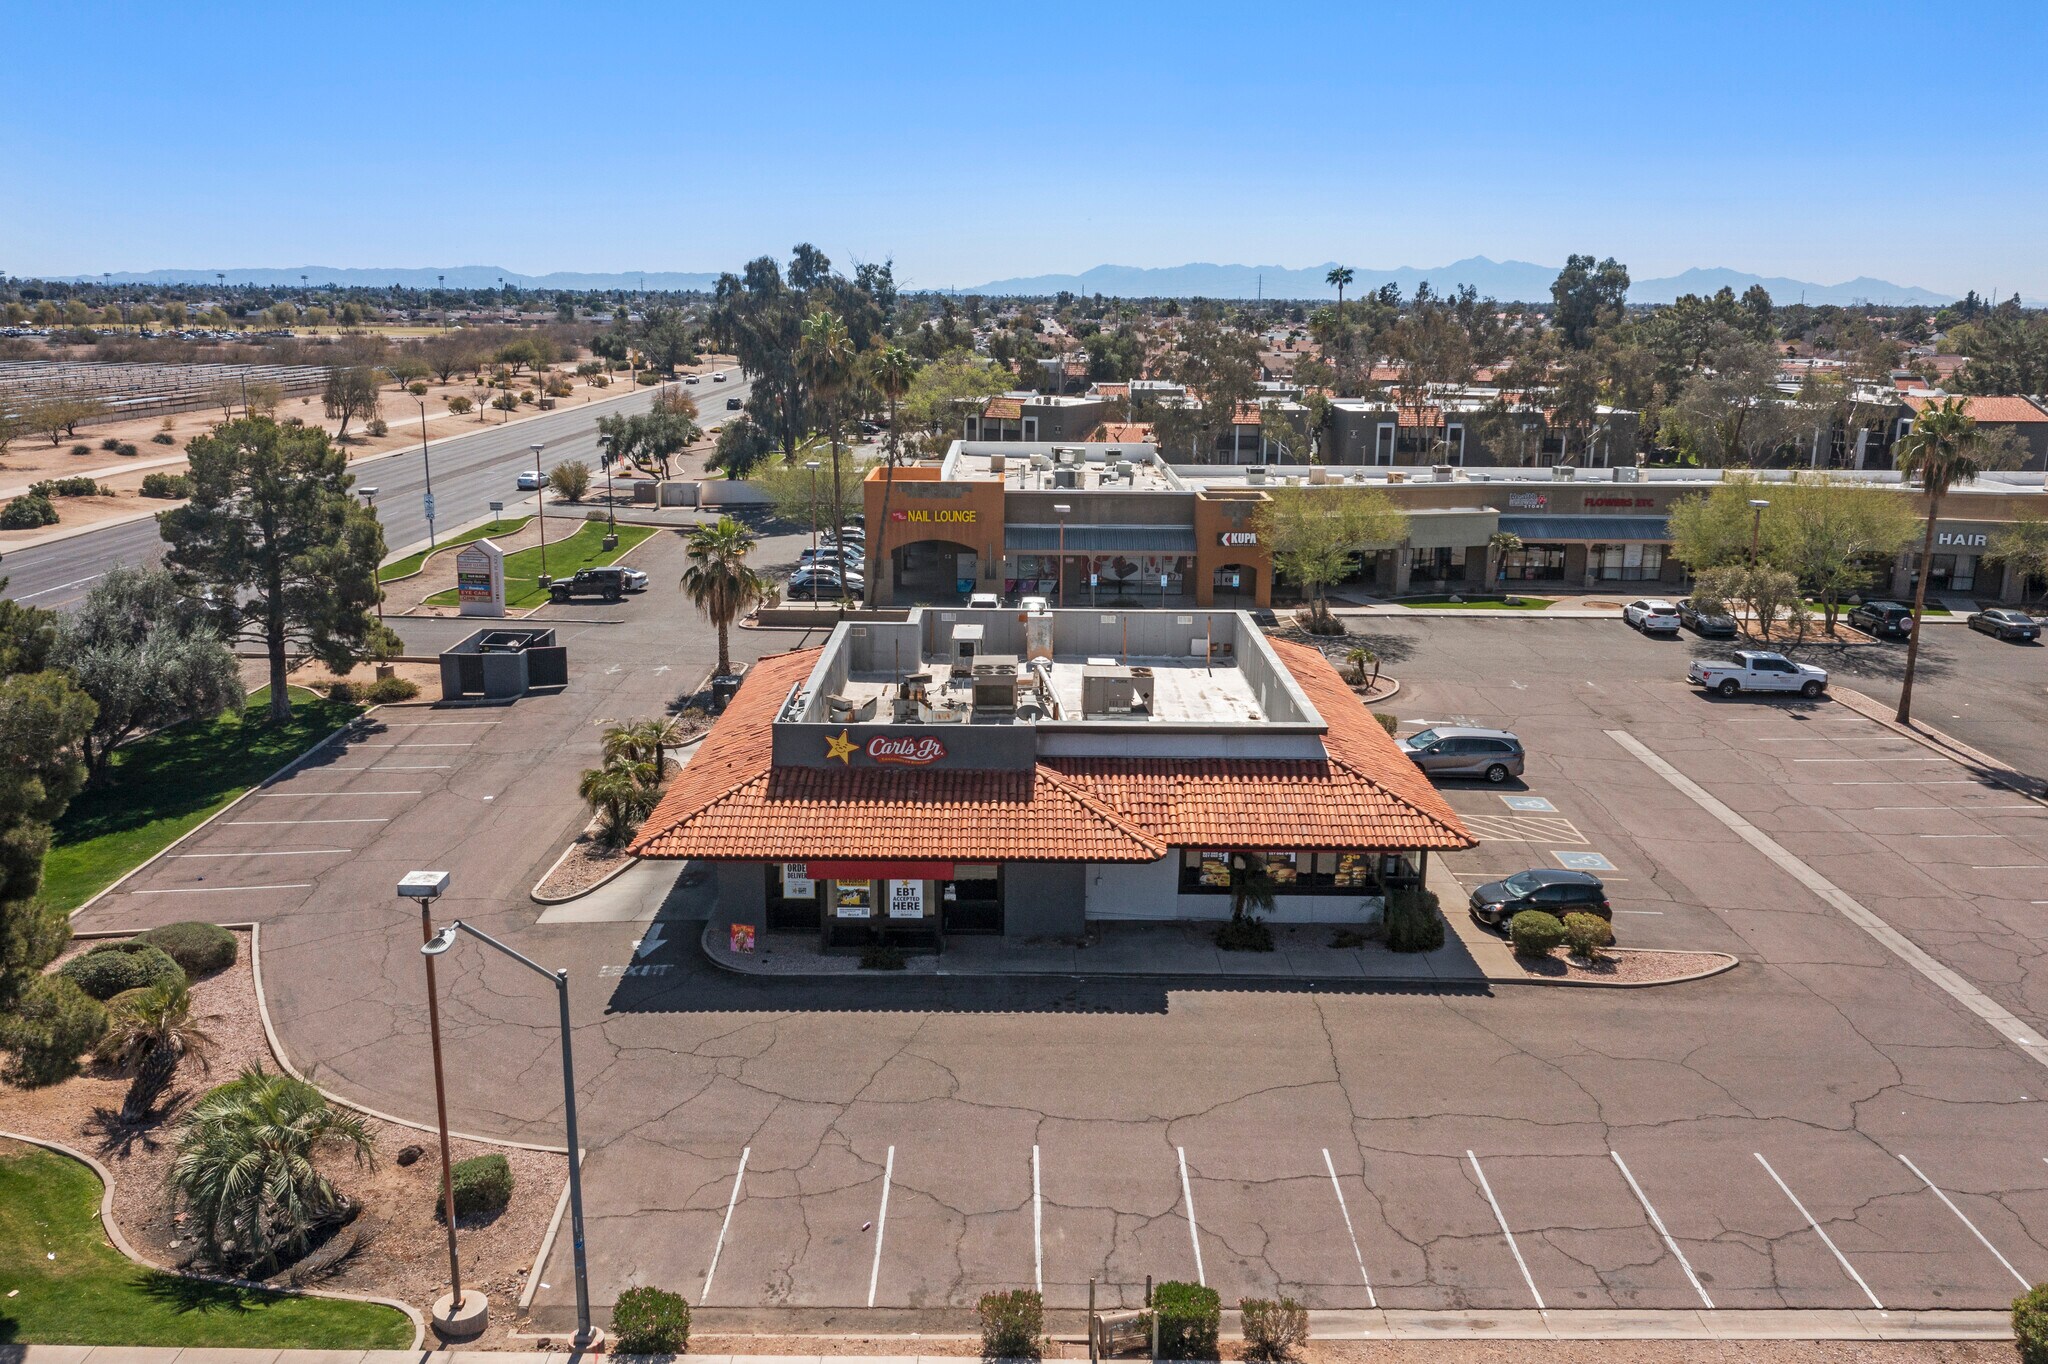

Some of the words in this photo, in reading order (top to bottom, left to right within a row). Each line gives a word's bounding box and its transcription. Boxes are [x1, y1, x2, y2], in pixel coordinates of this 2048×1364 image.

[1584, 498, 1633, 507] FLOWERS
[1635, 498, 1654, 507] ETC
[907, 510, 931, 522] NAIL
[934, 510, 976, 523] LOUNGE
[1231, 532, 1257, 544] KUPA
[1938, 533, 1987, 546] HAIR
[868, 737, 917, 757] Carl's
[916, 739, 944, 757] Jr.
[787, 863, 806, 873] ORDE
[896, 887, 916, 896] EBT
[893, 902, 920, 911] HERE
